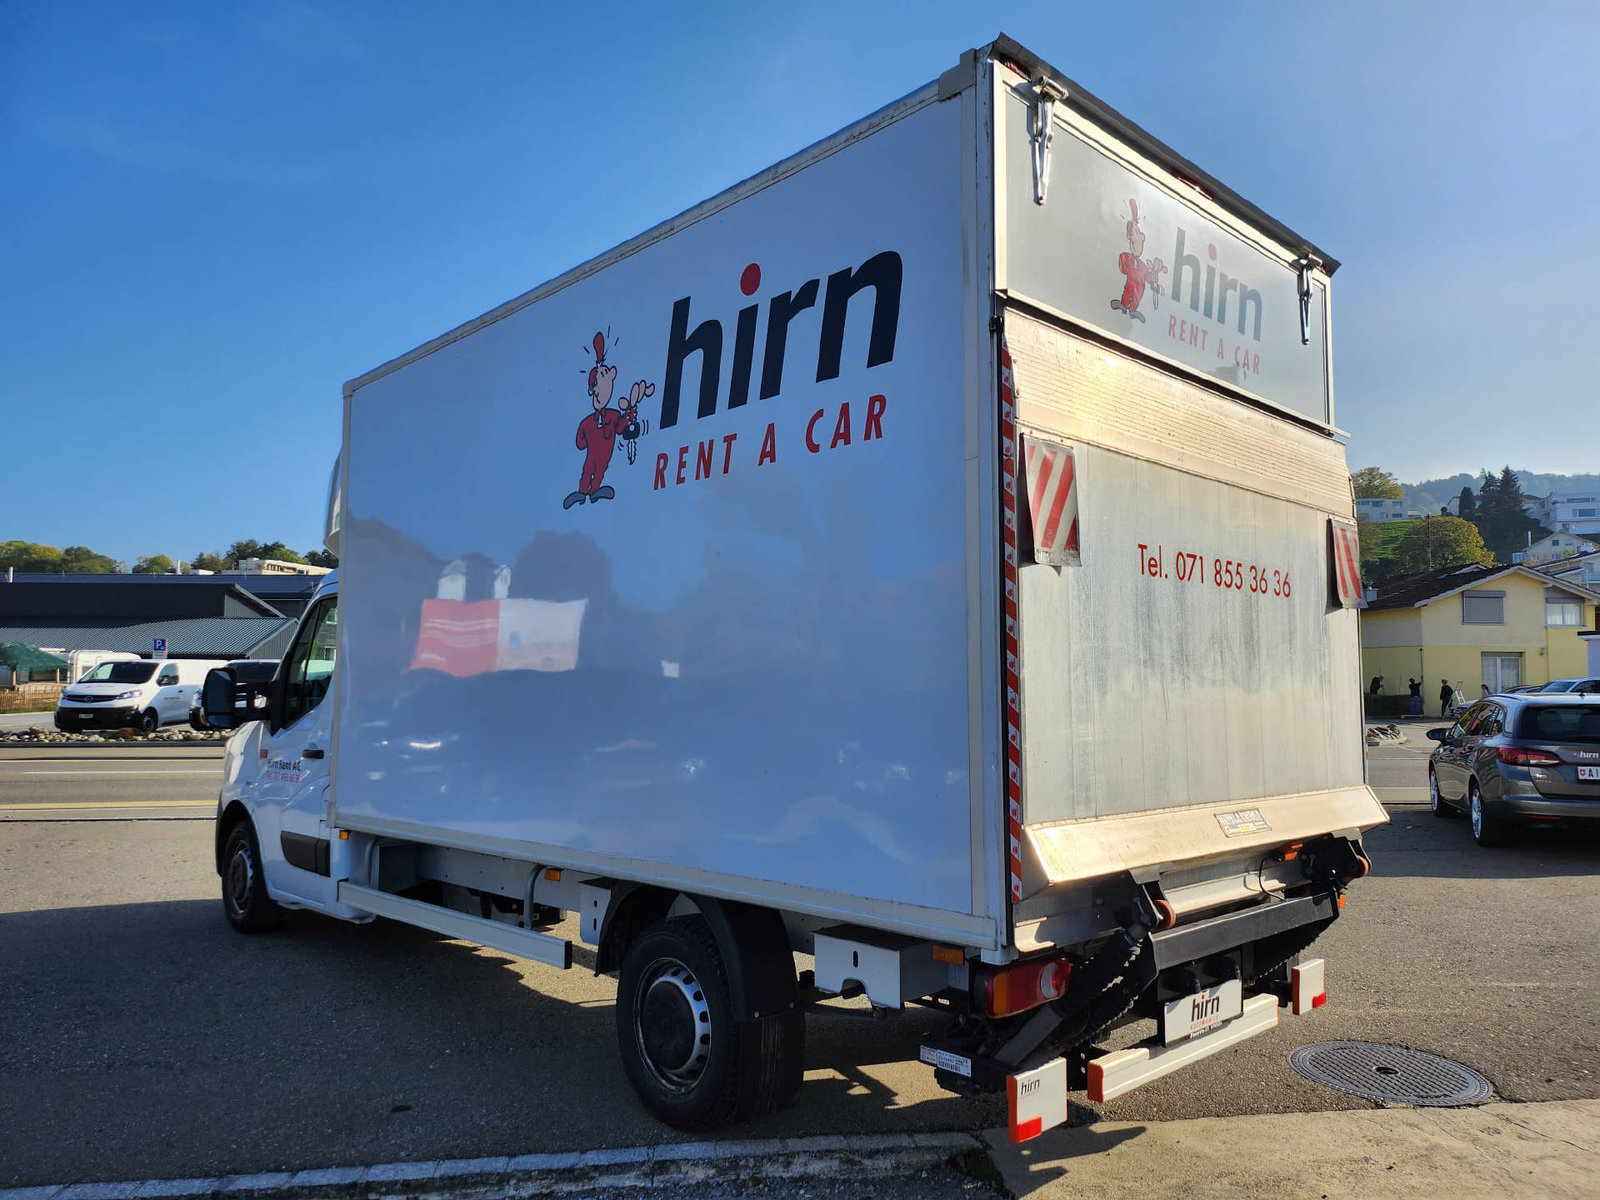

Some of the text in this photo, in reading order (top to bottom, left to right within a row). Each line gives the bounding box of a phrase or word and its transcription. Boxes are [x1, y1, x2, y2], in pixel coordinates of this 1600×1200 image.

[1171, 226, 1263, 342] hirn
[659, 250, 903, 430] hirn
[1168, 314, 1260, 374] RENT A CAR
[653, 394, 887, 491] RENT A CAR
[1137, 543, 1291, 598] Tel. 071 855 36 36
[1191, 994, 1220, 1022] hirn
[1021, 1079, 1040, 1095] hirn
